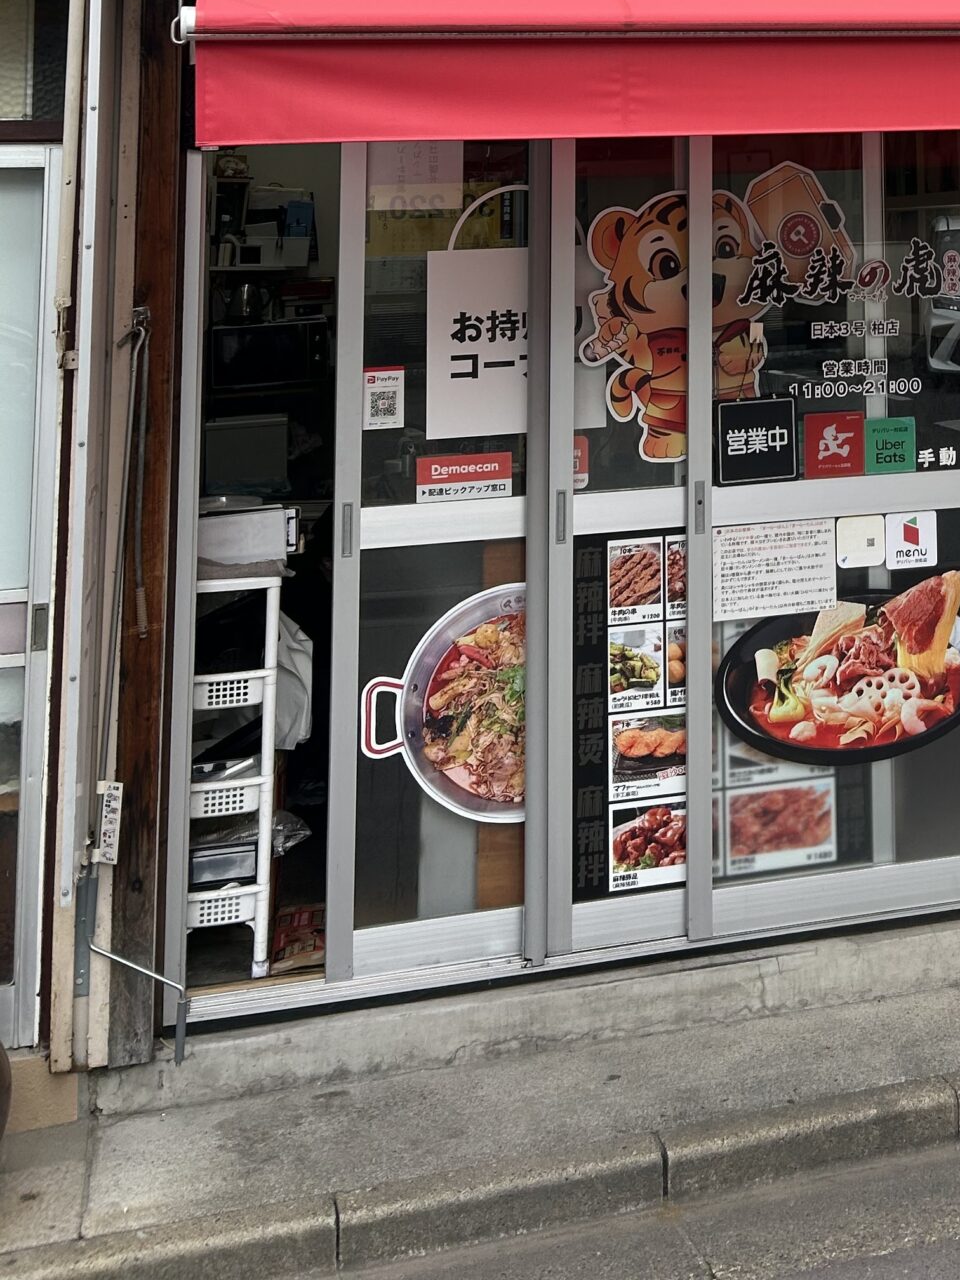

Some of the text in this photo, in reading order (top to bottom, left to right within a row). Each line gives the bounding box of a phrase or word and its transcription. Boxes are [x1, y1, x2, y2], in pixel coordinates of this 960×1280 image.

[736, 237, 944, 308] 麻辣の虎
[811, 321, 866, 339] 日本3号
[450, 353, 528, 380] コー
[822, 359, 888, 378] 営業時間
[726, 426, 789, 456] 営業中
[875, 439, 906, 451] Uber
[876, 452, 906, 464] Eats
[917, 447, 957, 468] 手動
[431, 462, 499, 478] Demaecan
[428, 483, 506, 497] 配達ピックアップ窓口
[896, 548, 928, 558] menu
